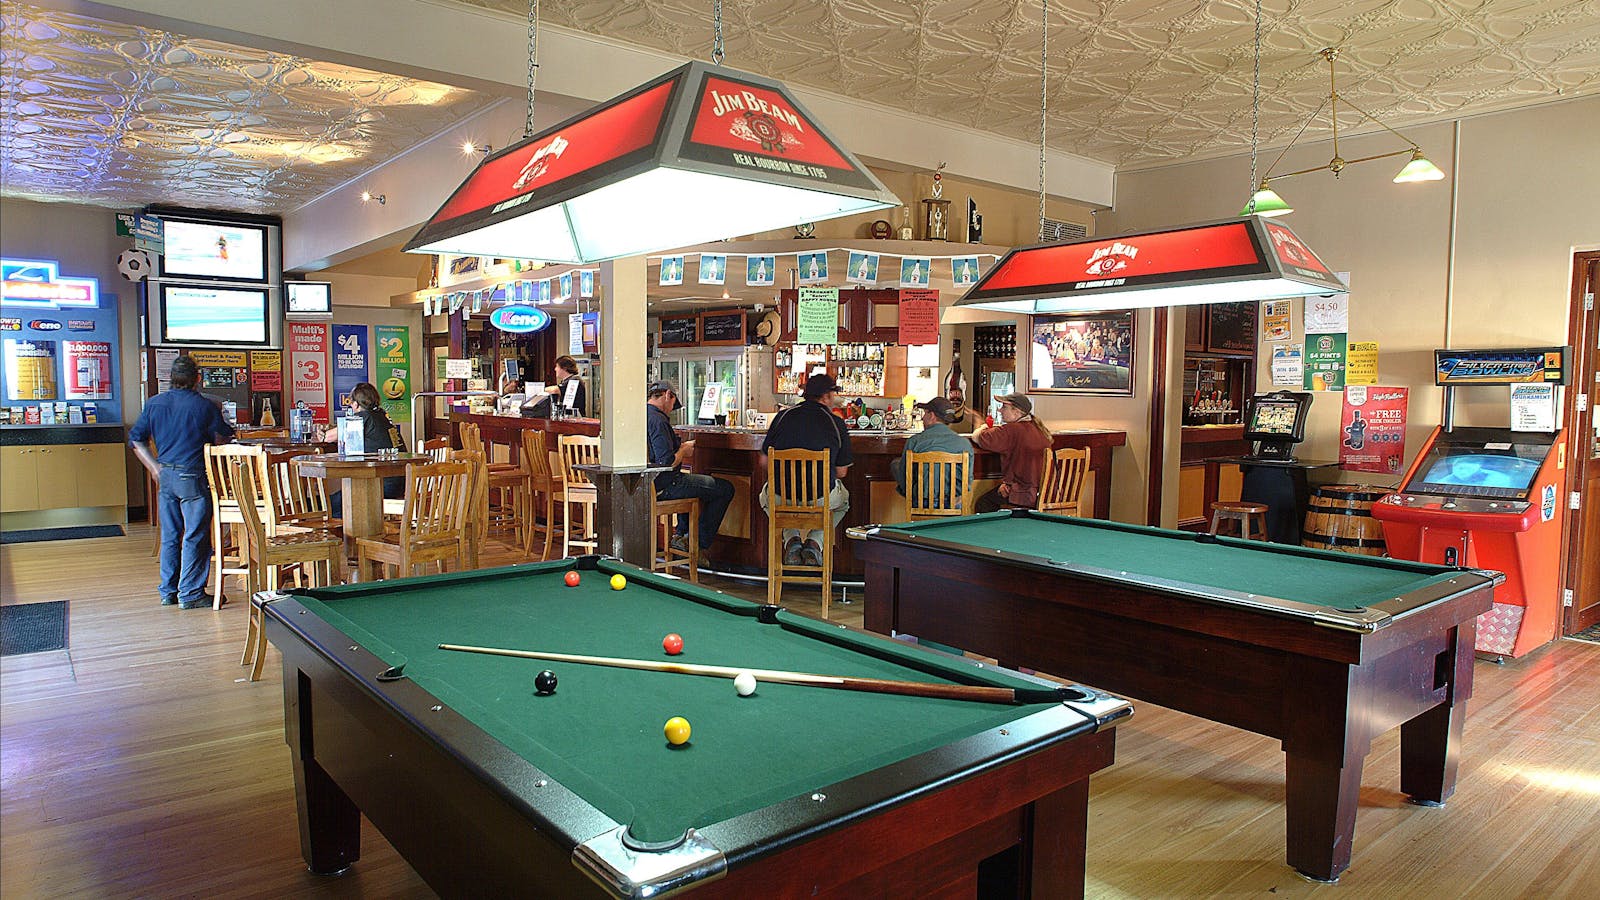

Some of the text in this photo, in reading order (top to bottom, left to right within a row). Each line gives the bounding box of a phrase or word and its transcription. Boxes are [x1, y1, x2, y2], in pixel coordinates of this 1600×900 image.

[710, 90, 804, 133] JIM BEAM
[733, 153, 828, 179] REAL BOURBON SINCE 1795
[1086, 242, 1139, 265] JIM BEAM
[1314, 302, 1338, 312] $4.50
[500, 311, 540, 326] Keno
[30, 320, 61, 330] Keno
[292, 325, 324, 334] Multi's
[294, 335, 322, 343] made
[337, 334, 361, 355] $4
[297, 343, 320, 351] here
[380, 337, 404, 357] $2
[297, 360, 320, 380] $3
[1458, 361, 1499, 369] SILVER
[389, 380, 399, 391] 7
[1375, 409, 1402, 418] FREE
